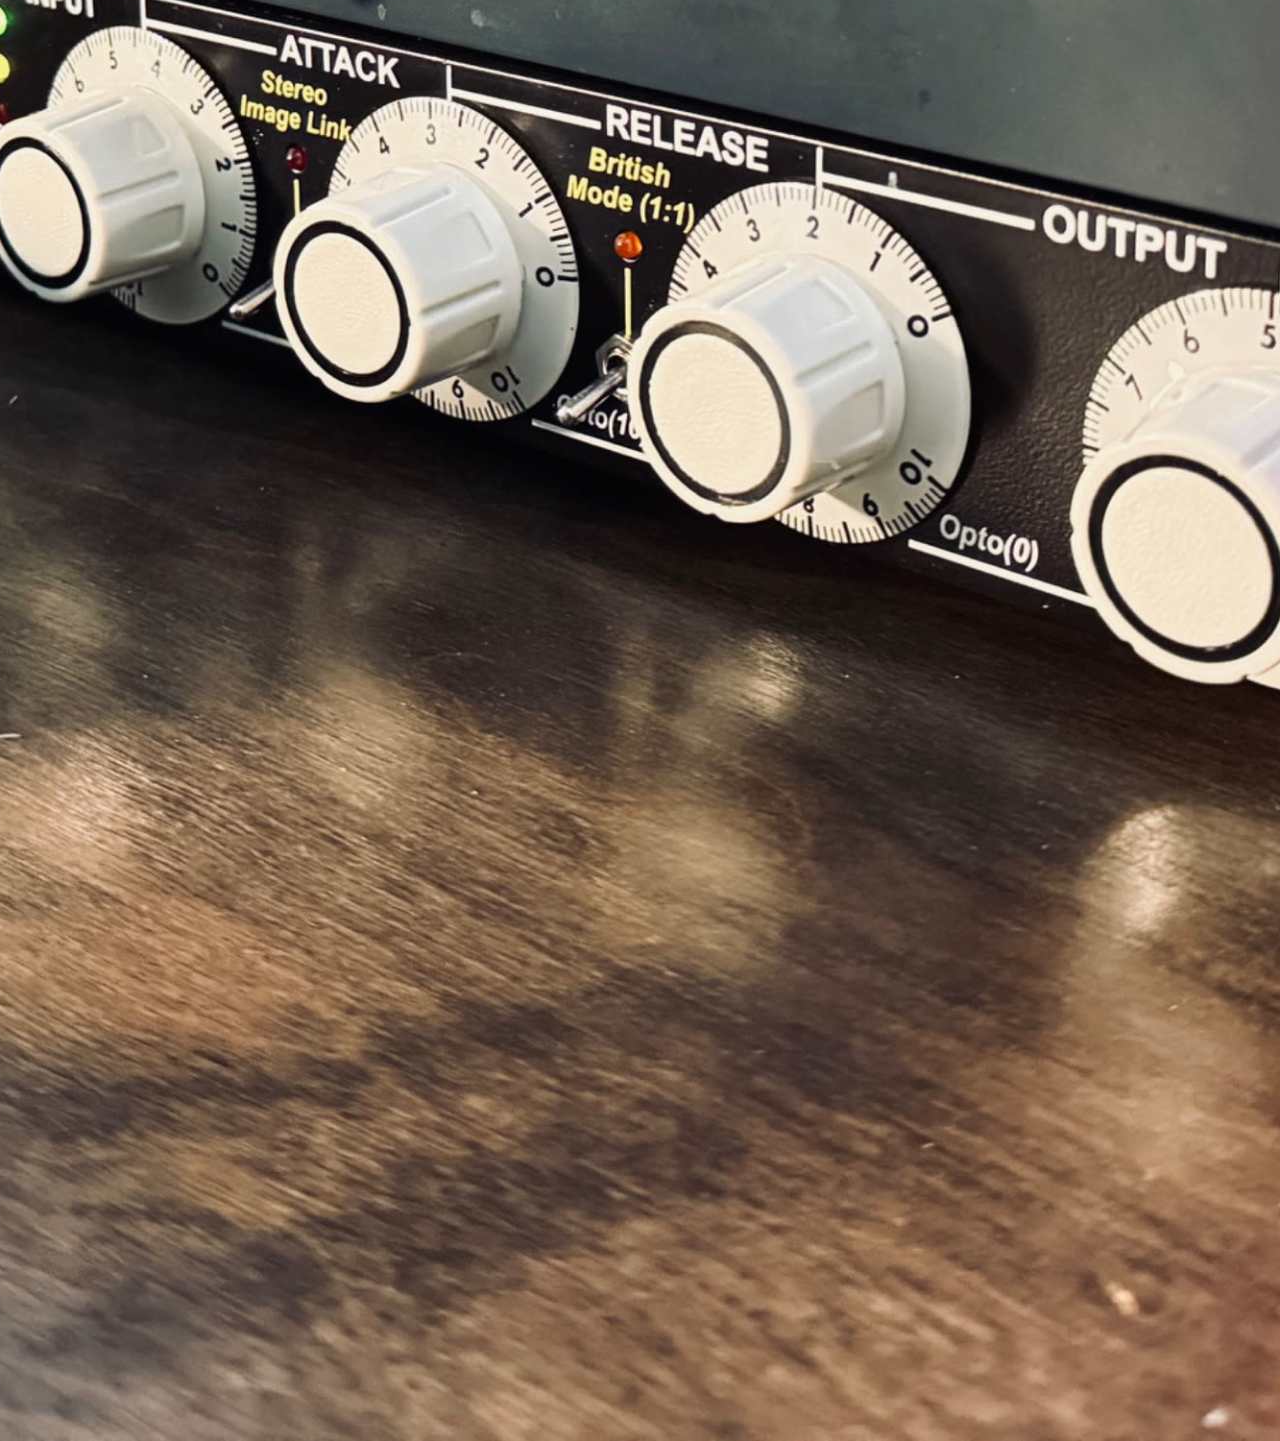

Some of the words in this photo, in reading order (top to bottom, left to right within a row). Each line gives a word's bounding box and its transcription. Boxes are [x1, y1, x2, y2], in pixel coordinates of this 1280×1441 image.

[108, 50, 119, 70] 5
[279, 33, 402, 89] ATTACK
[260, 68, 329, 107] Stereo
[190, 97, 206, 116] 3
[239, 94, 303, 135] Image
[305, 113, 353, 143] Link
[378, 135, 391, 155] 4
[424, 124, 438, 146] 3
[604, 103, 770, 173] RELEASE
[215, 156, 233, 173] 2
[474, 147, 491, 170] 2
[587, 146, 671, 189] British
[566, 174, 634, 215] Mode
[639, 193, 696, 235] (1:1)
[746, 218, 762, 242] 3
[805, 215, 820, 239] 2
[1042, 203, 1228, 280] OUTPUT
[700, 258, 719, 280] 4
[1182, 327, 1201, 355] 6
[1259, 324, 1277, 351] 5
[1123, 374, 1145, 402] 7
[938, 513, 1040, 573] Opto(0)
